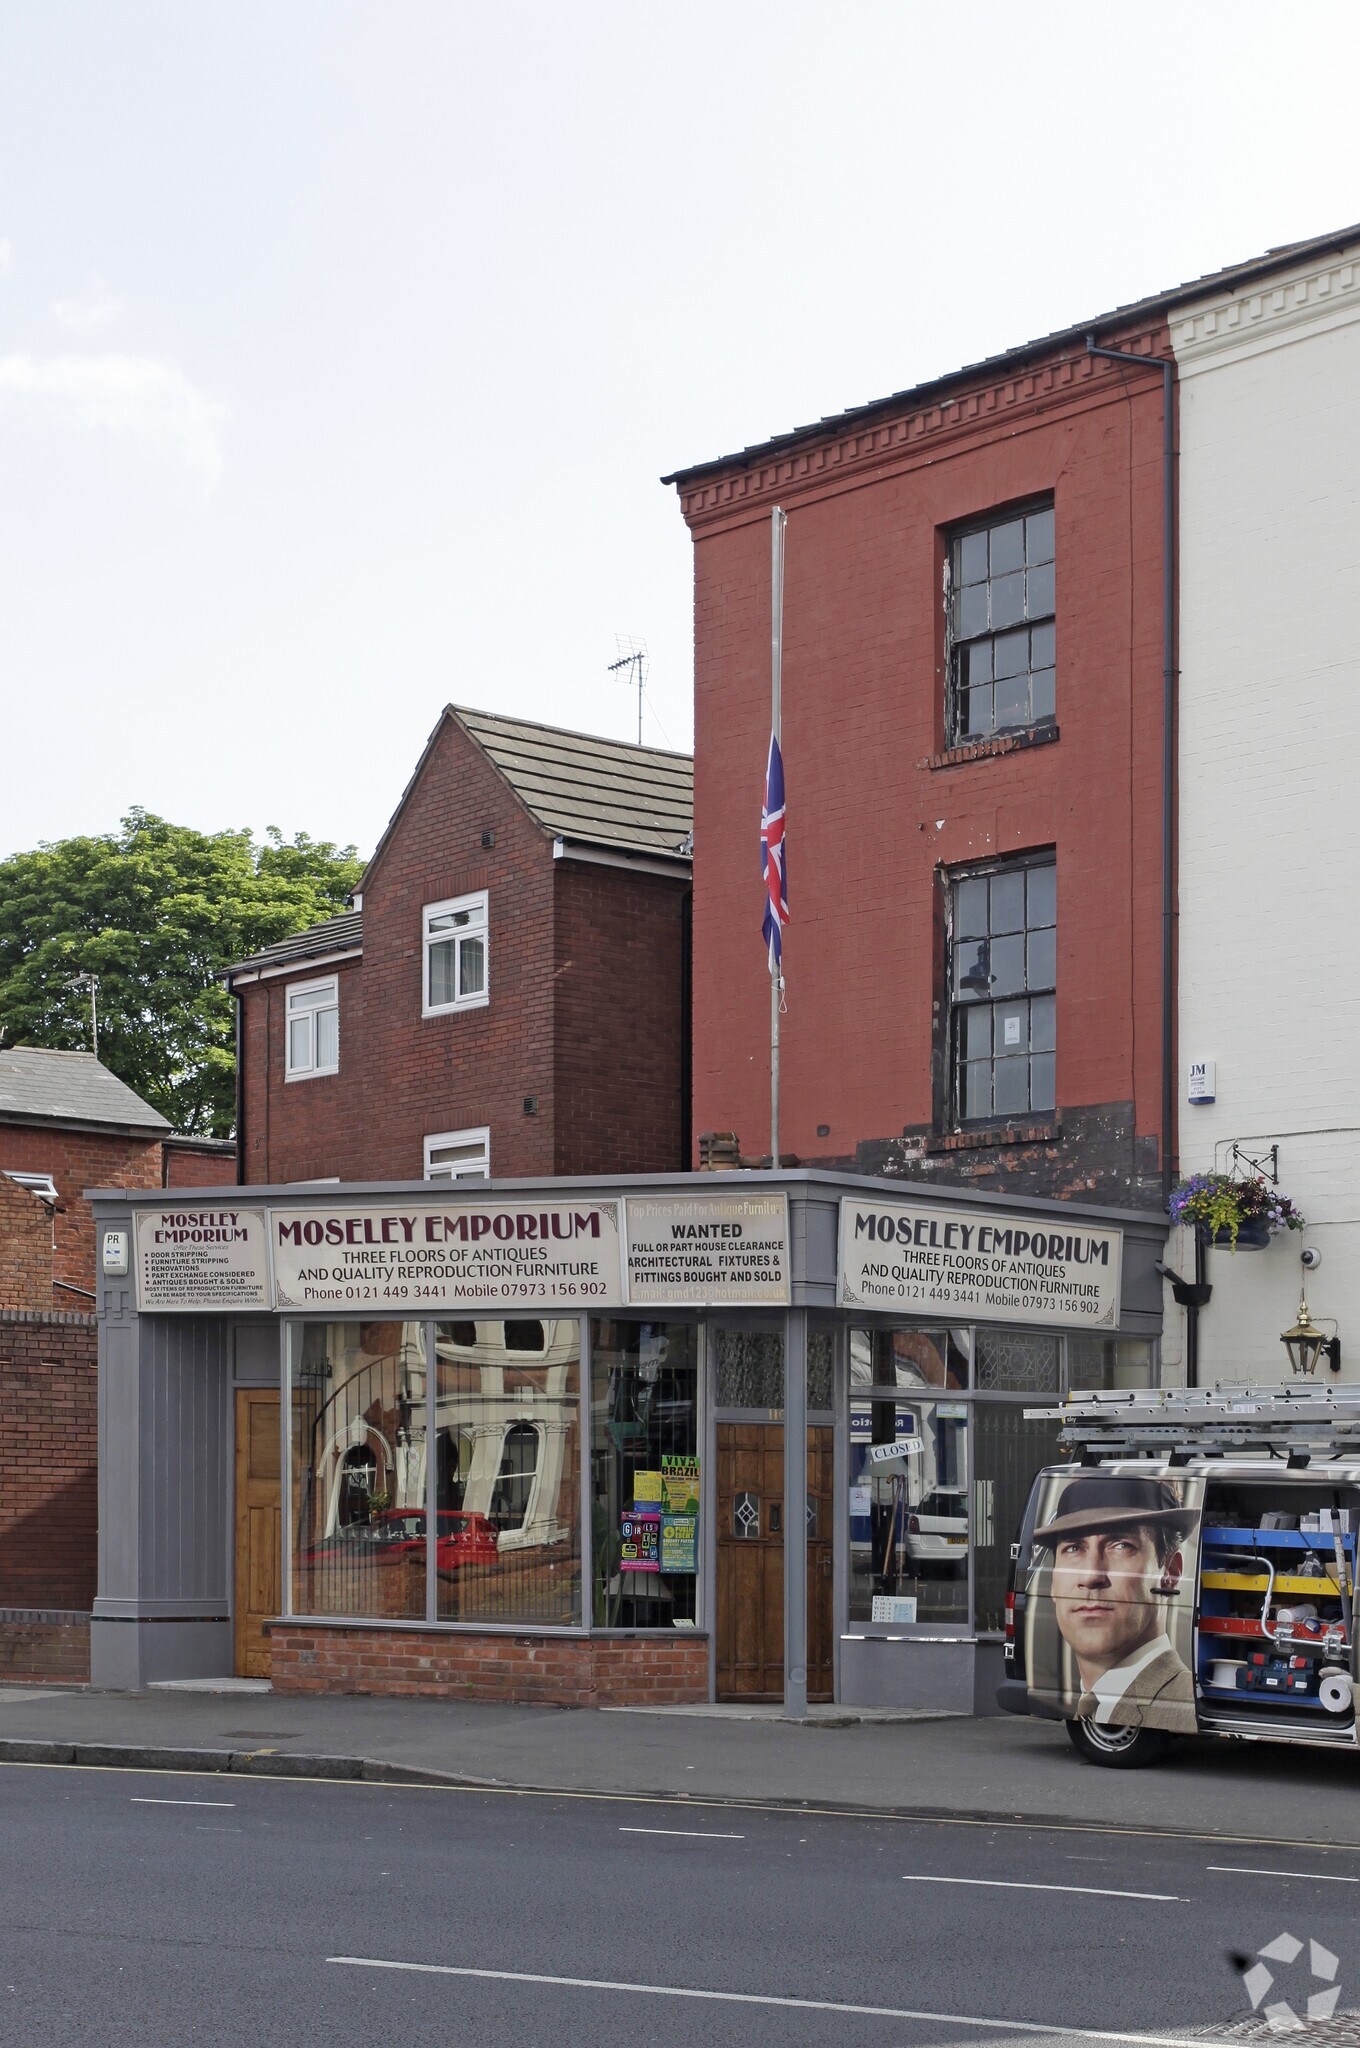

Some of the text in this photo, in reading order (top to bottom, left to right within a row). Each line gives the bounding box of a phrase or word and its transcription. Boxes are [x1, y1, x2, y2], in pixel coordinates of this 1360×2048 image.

[1190, 1064, 1206, 1077] JM
[628, 1204, 644, 1219] Top
[646, 1203, 672, 1217] Prices
[674, 1202, 692, 1217] Paid
[694, 1202, 708, 1216] For
[709, 1201, 743, 1219] Antique
[162, 1213, 239, 1228] MOSELEY
[155, 1228, 248, 1243] EMPORIUM
[279, 1212, 600, 1246] MOSELEY EMPORIUM
[672, 1224, 742, 1238] WANTED
[107, 1234, 120, 1244] P.R.
[632, 1241, 784, 1252] FULL OR PART HOUSE CLEARANCE
[854, 1212, 1110, 1266] MOSELEY EMPORIUM
[342, 1247, 548, 1264] THREE FLOORS OF ANTIQUES
[628, 1255, 780, 1268] ARCHITECTURAL FIXTURES &
[298, 1262, 599, 1282] AND QUALITY REPRODUCTION FURNITURE
[903, 1250, 1066, 1279] THREE FLOORS OF ANTIQUES
[634, 1270, 782, 1282] FITTINGS BOUGHT AND SOLD
[861, 1263, 1100, 1298] AND QUALITY REPRODUCTION FURNITURE
[304, 1282, 608, 1299] Phone 0121 449 3441 Mobile 07973 156 902
[862, 1280, 1099, 1314] Phone 0121 449 3441 Mobile 07973 156 902
[874, 1440, 920, 1459] CLOSED
[666, 1456, 696, 1467] VIVA
[662, 1466, 700, 1477] BRAZIL
